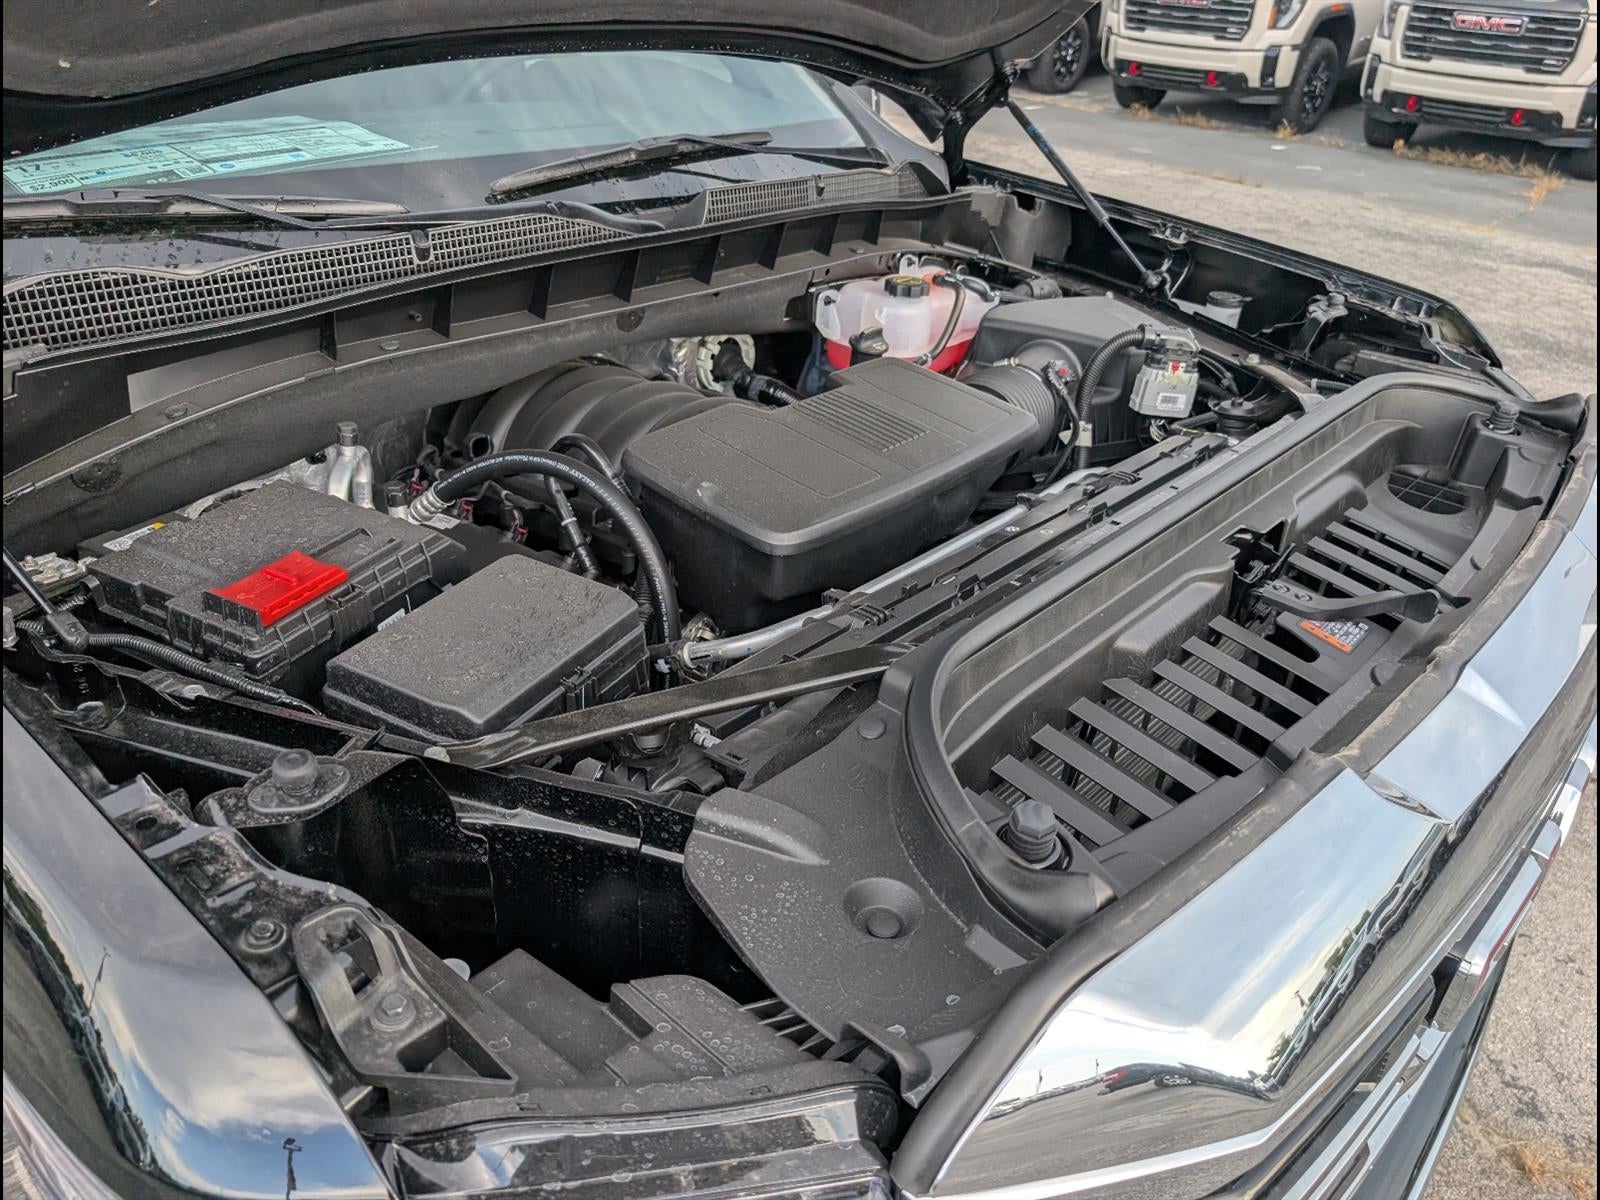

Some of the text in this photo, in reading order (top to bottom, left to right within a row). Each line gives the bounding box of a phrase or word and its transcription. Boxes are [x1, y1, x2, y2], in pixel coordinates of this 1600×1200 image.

[1455, 14, 1522, 33] GMC
[30, 178, 74, 191] $2,900
[569, 468, 596, 488] GALAXY
